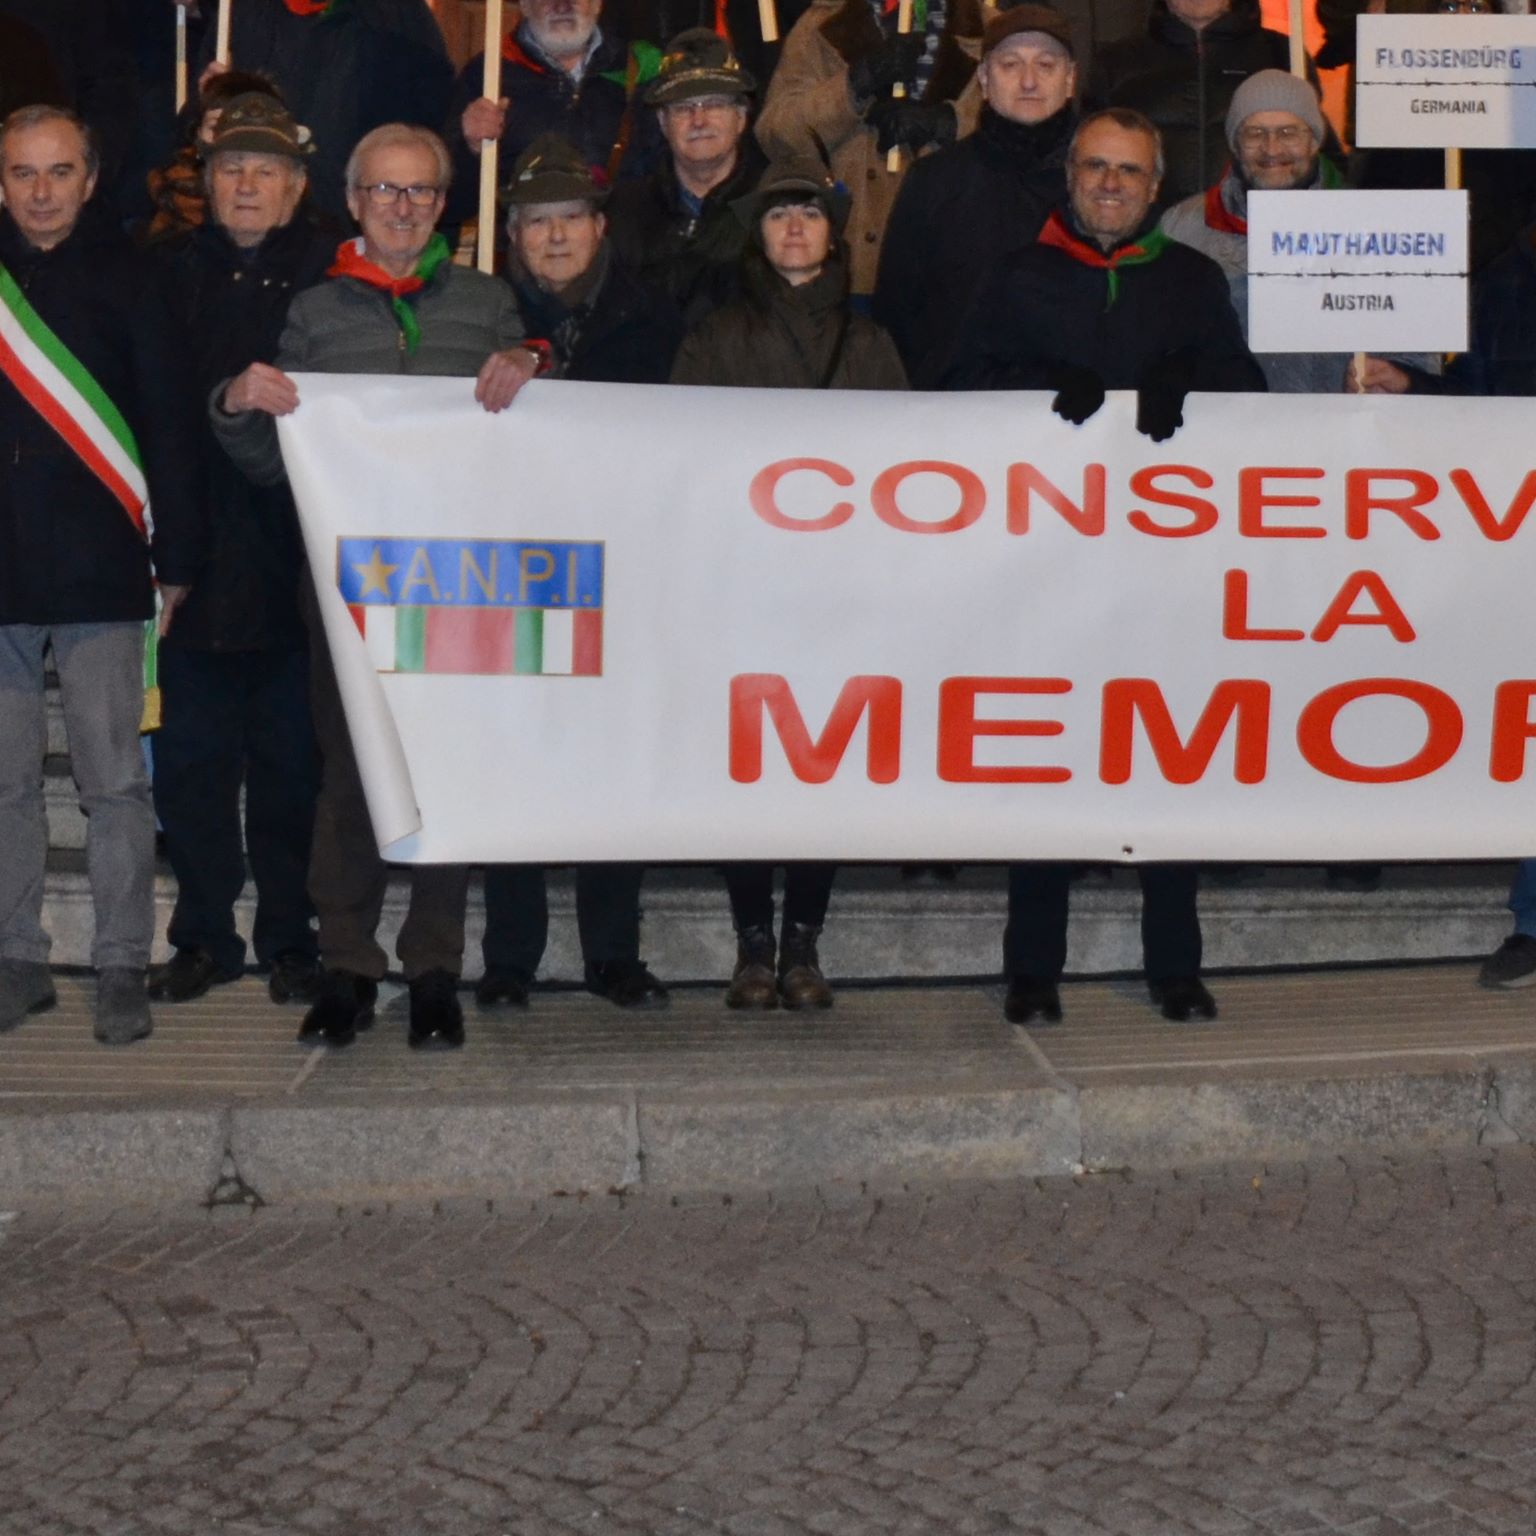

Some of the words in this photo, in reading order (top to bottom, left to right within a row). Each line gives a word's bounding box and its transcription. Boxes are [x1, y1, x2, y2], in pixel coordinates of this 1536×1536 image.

[1375, 45, 1523, 69] FLOSSENBÜRG
[1410, 99, 1487, 114] GERMANIA
[1272, 231, 1445, 256] MAUTHAUSEN
[1321, 292, 1394, 311] AUSTRIA
[1222, 568, 1417, 643] LA
